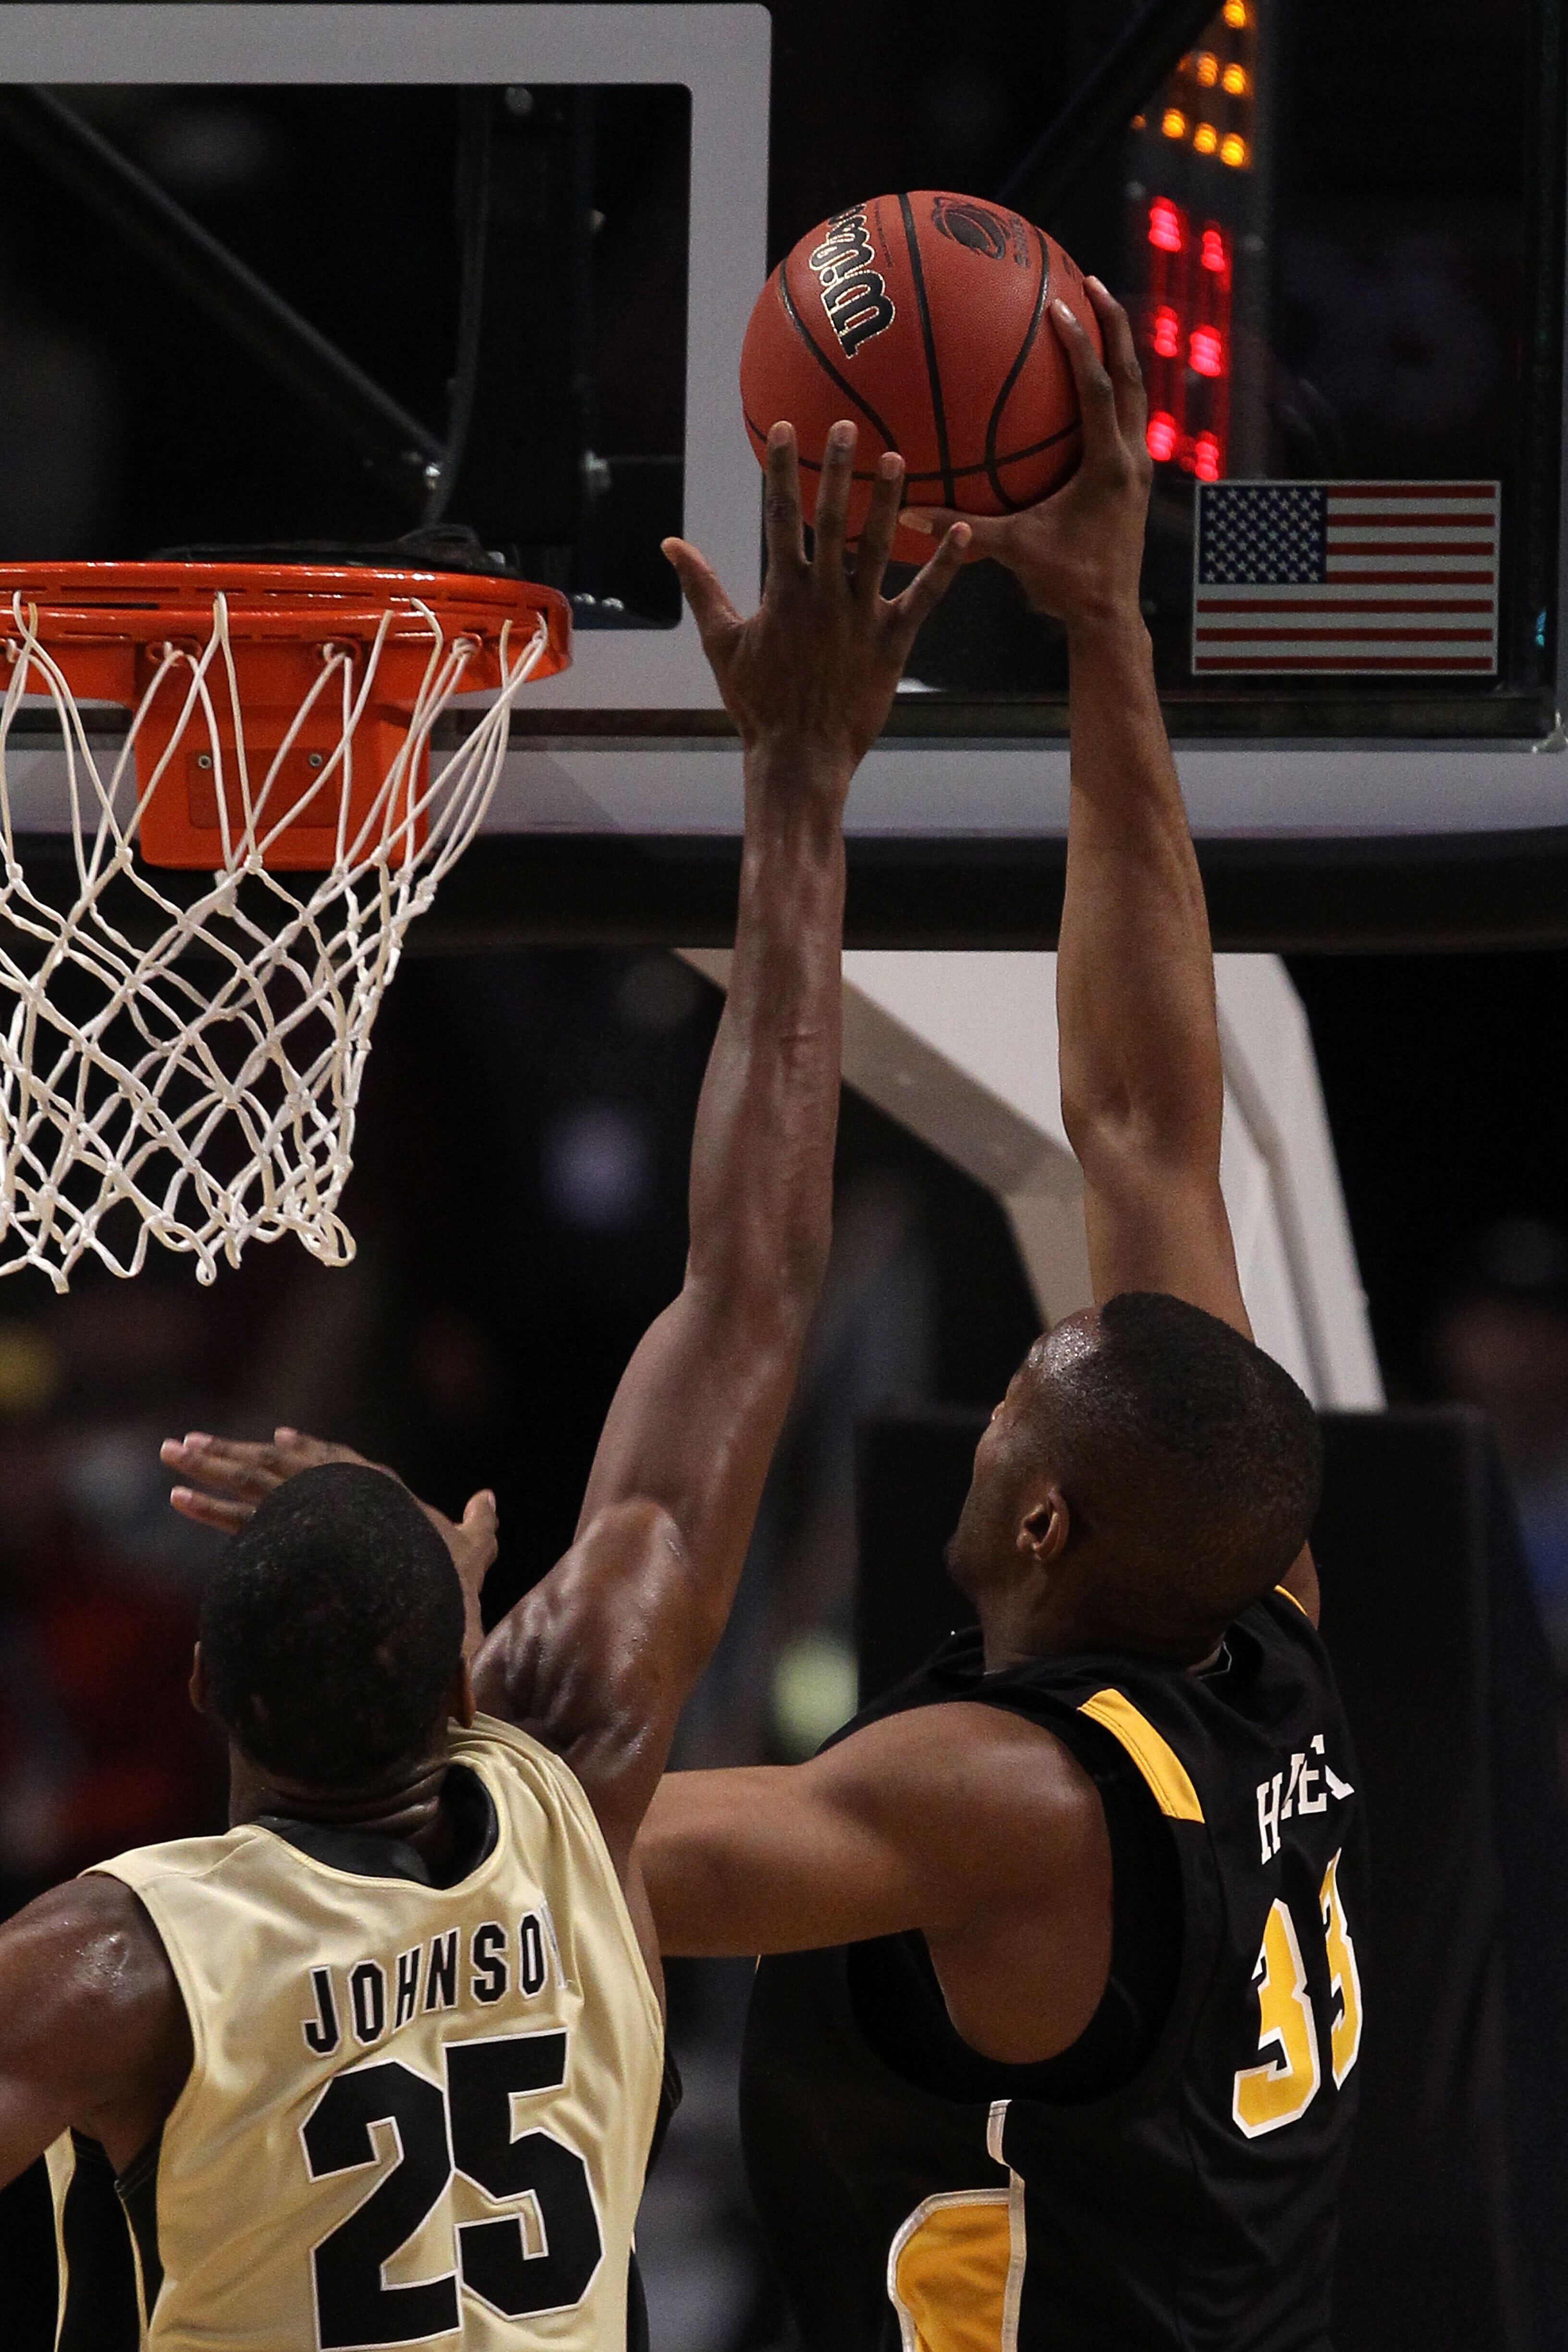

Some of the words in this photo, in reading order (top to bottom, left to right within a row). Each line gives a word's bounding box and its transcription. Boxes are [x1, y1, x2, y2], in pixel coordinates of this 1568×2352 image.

[809, 203, 896, 359] Wilso
[302, 1900, 566, 2058] JOHNSO
[1232, 1846, 1364, 2139] 33
[297, 2025, 606, 2352] 25
